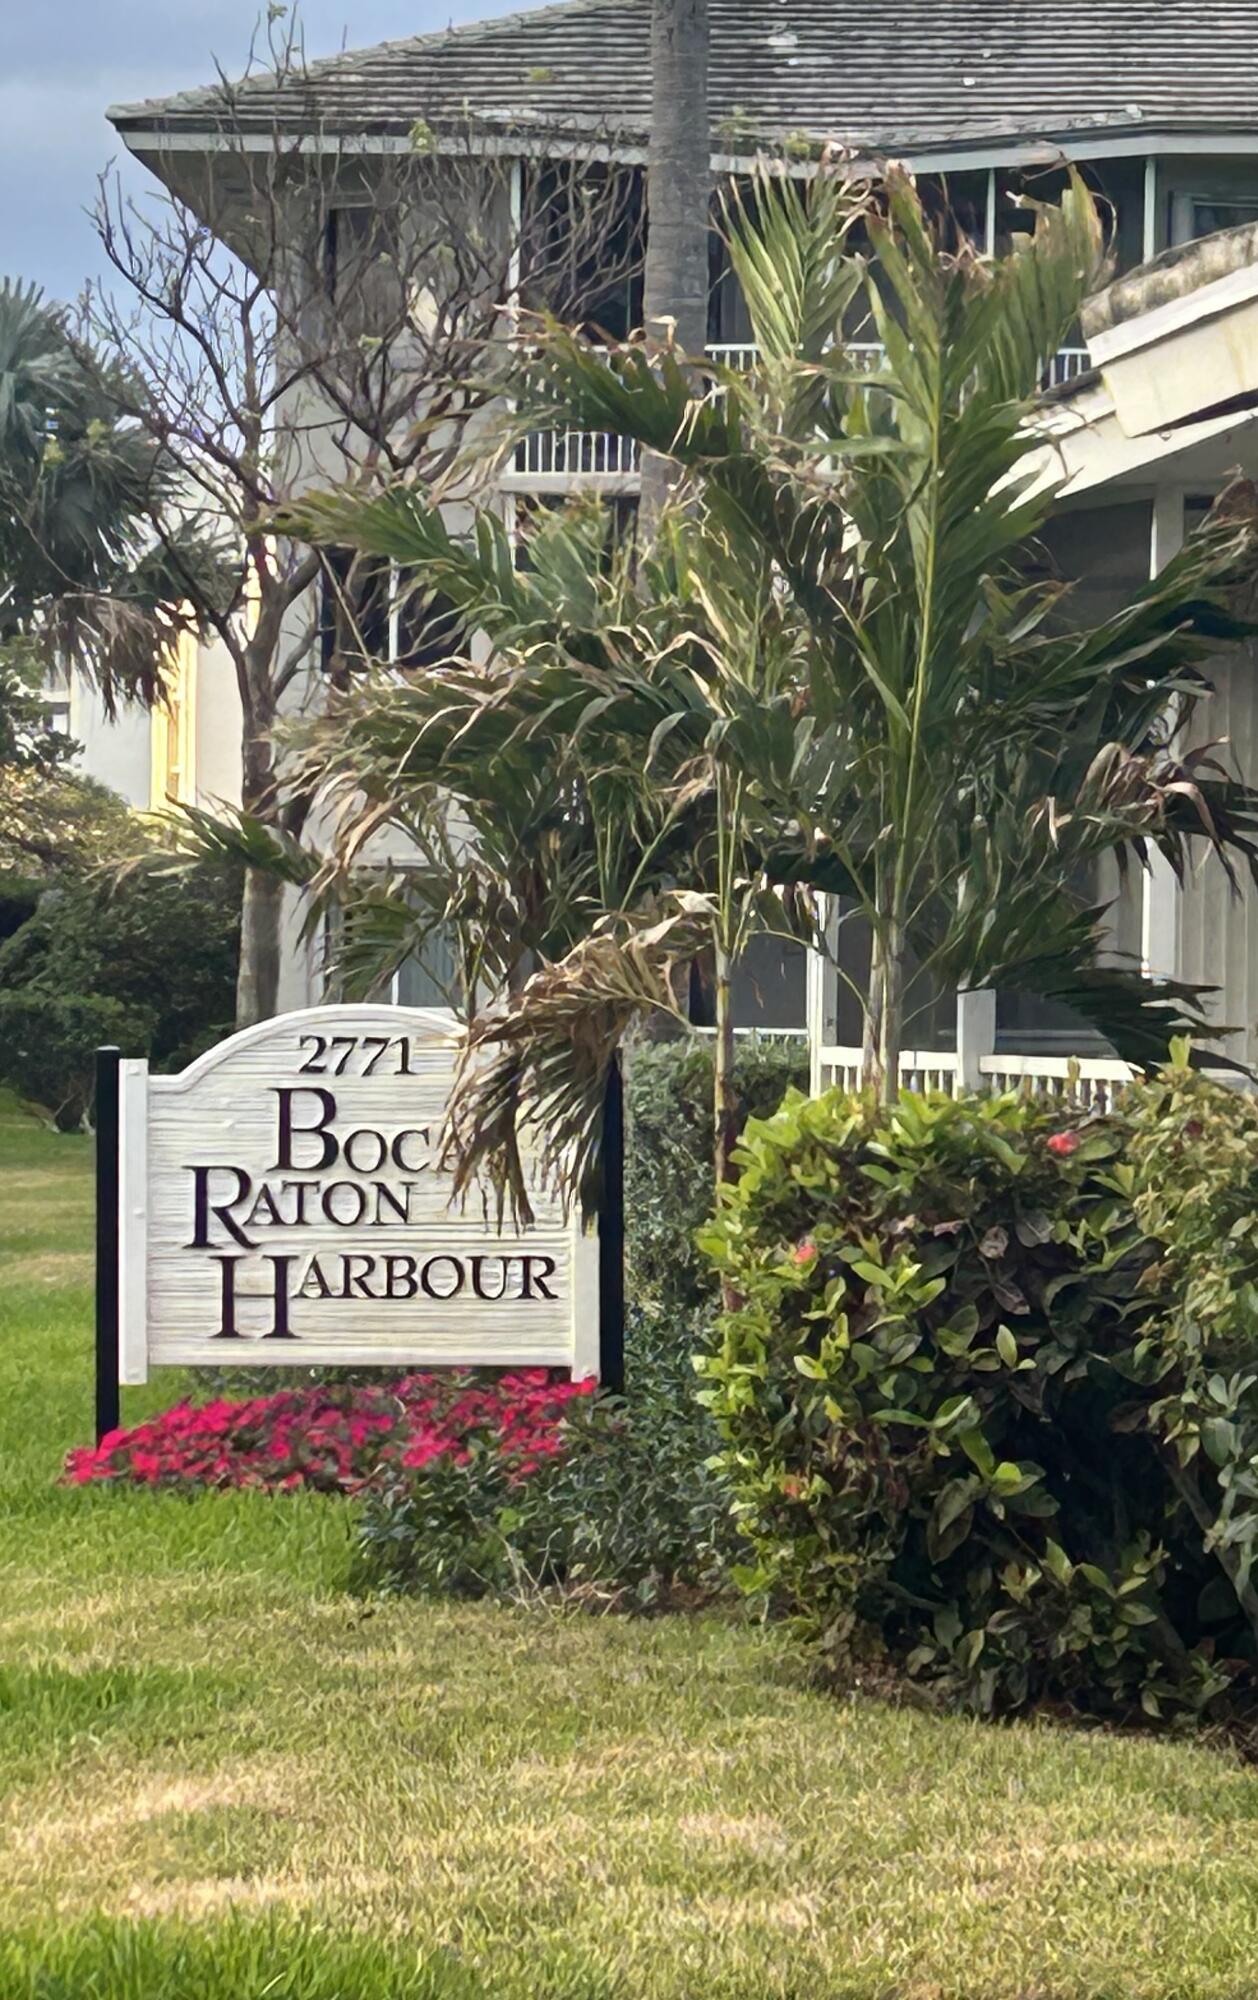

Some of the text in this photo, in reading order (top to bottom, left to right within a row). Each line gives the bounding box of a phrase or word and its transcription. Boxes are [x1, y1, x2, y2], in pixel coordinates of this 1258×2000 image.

[300, 1036, 417, 1076] 2771
[182, 1165, 418, 1250] RATON
[209, 1254, 559, 1339] HARBOUR
